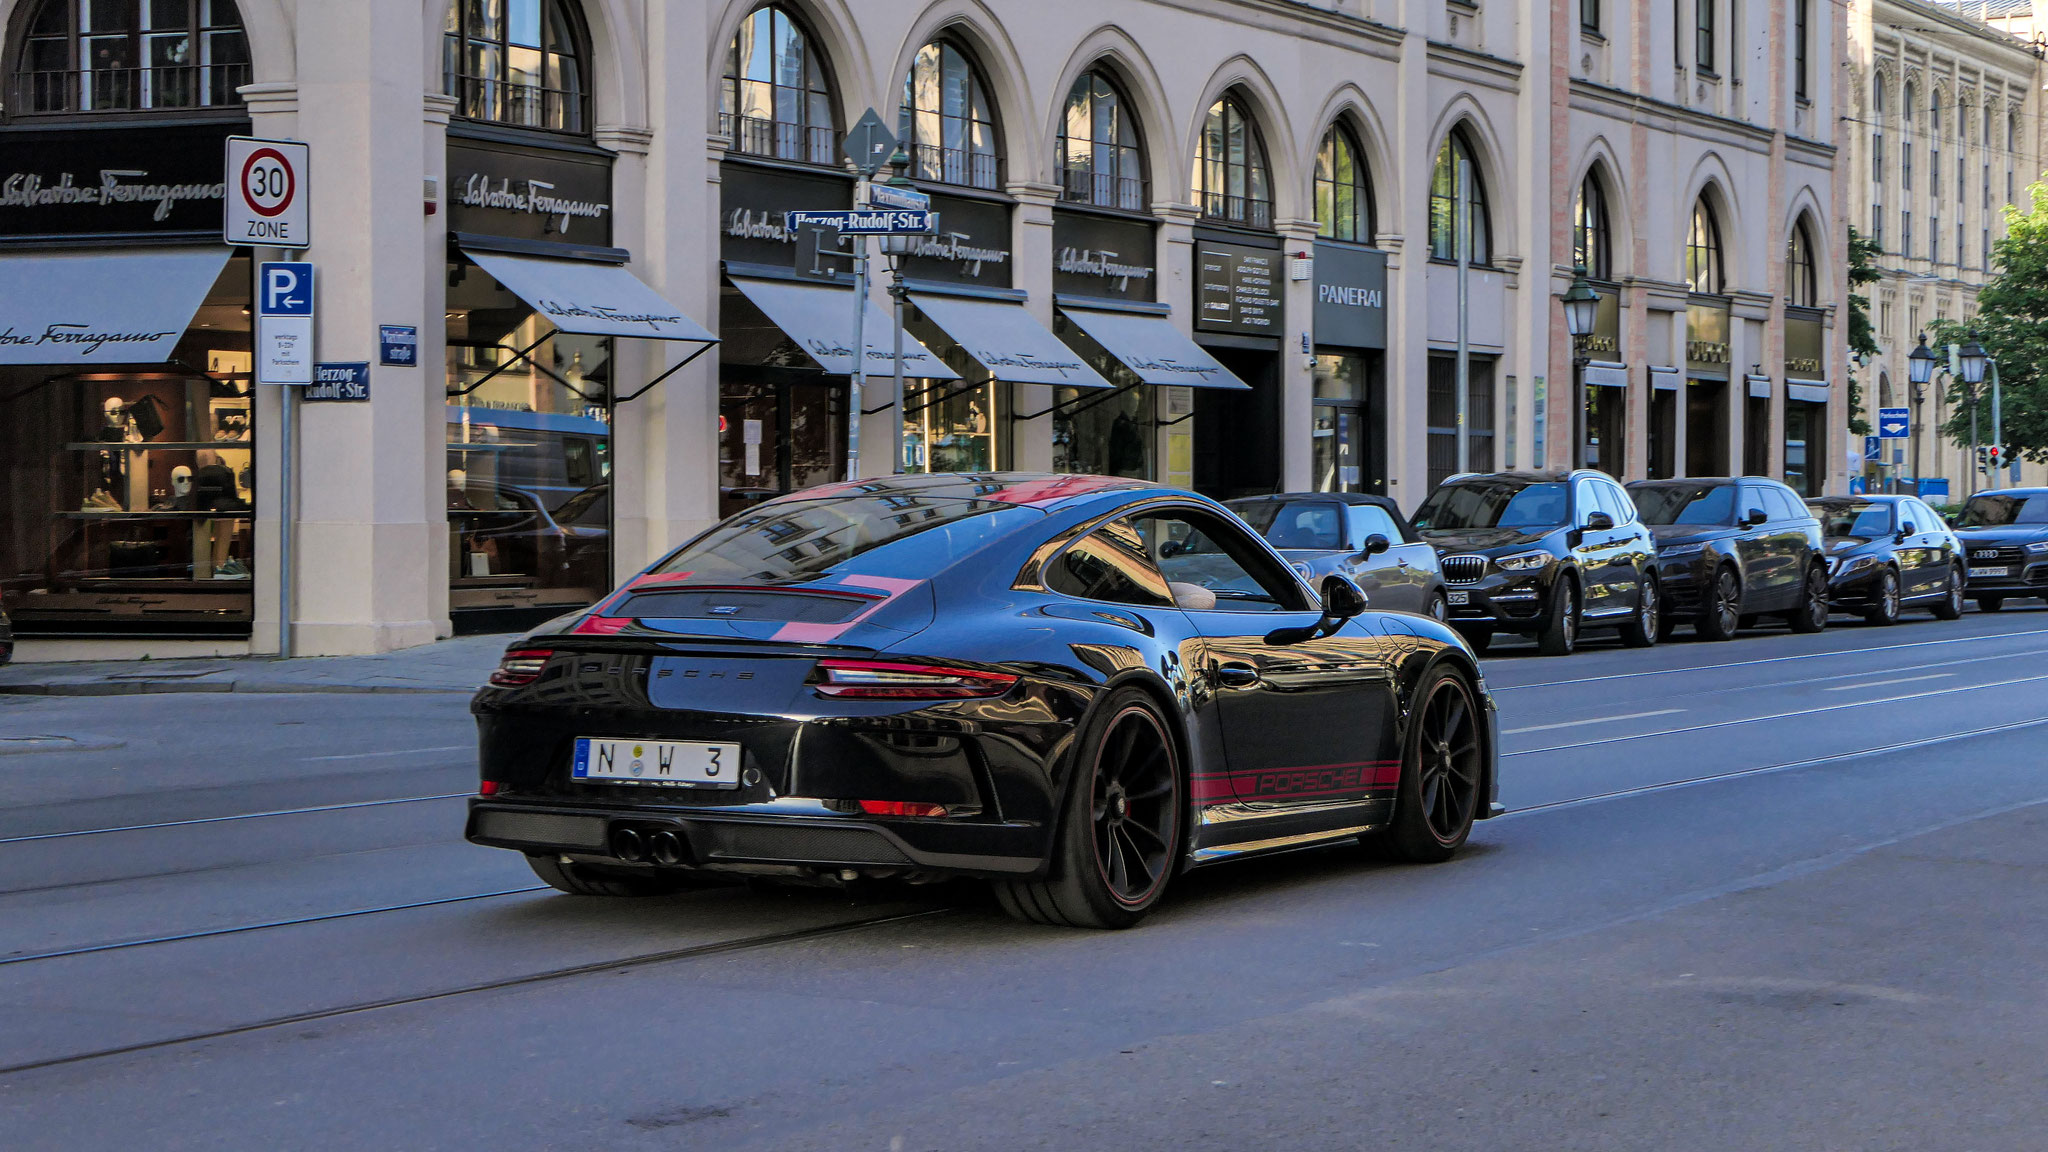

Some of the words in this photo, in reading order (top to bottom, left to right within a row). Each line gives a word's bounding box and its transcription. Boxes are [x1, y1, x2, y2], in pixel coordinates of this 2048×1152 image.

[252, 166, 283, 198] 30
[99, 170, 224, 222] Ferragamo
[462, 173, 528, 209] Salvatore
[526, 179, 609, 234] Ferragamo
[247, 220, 289, 239] ZONE
[268, 270, 297, 308] P
[1319, 284, 1381, 308] PANERAI
[35, 323, 176, 355] Ferragamo
[314, 365, 357, 382] Herzog-
[305, 382, 367, 399] Rudolf-Str.
[1448, 593, 1467, 604] 325
[584, 665, 755, 681] PORSCHE
[598, 743, 615, 773] N
[658, 745, 674, 775] W
[704, 747, 721, 777] 3
[1259, 766, 1359, 793] PORSCHE
